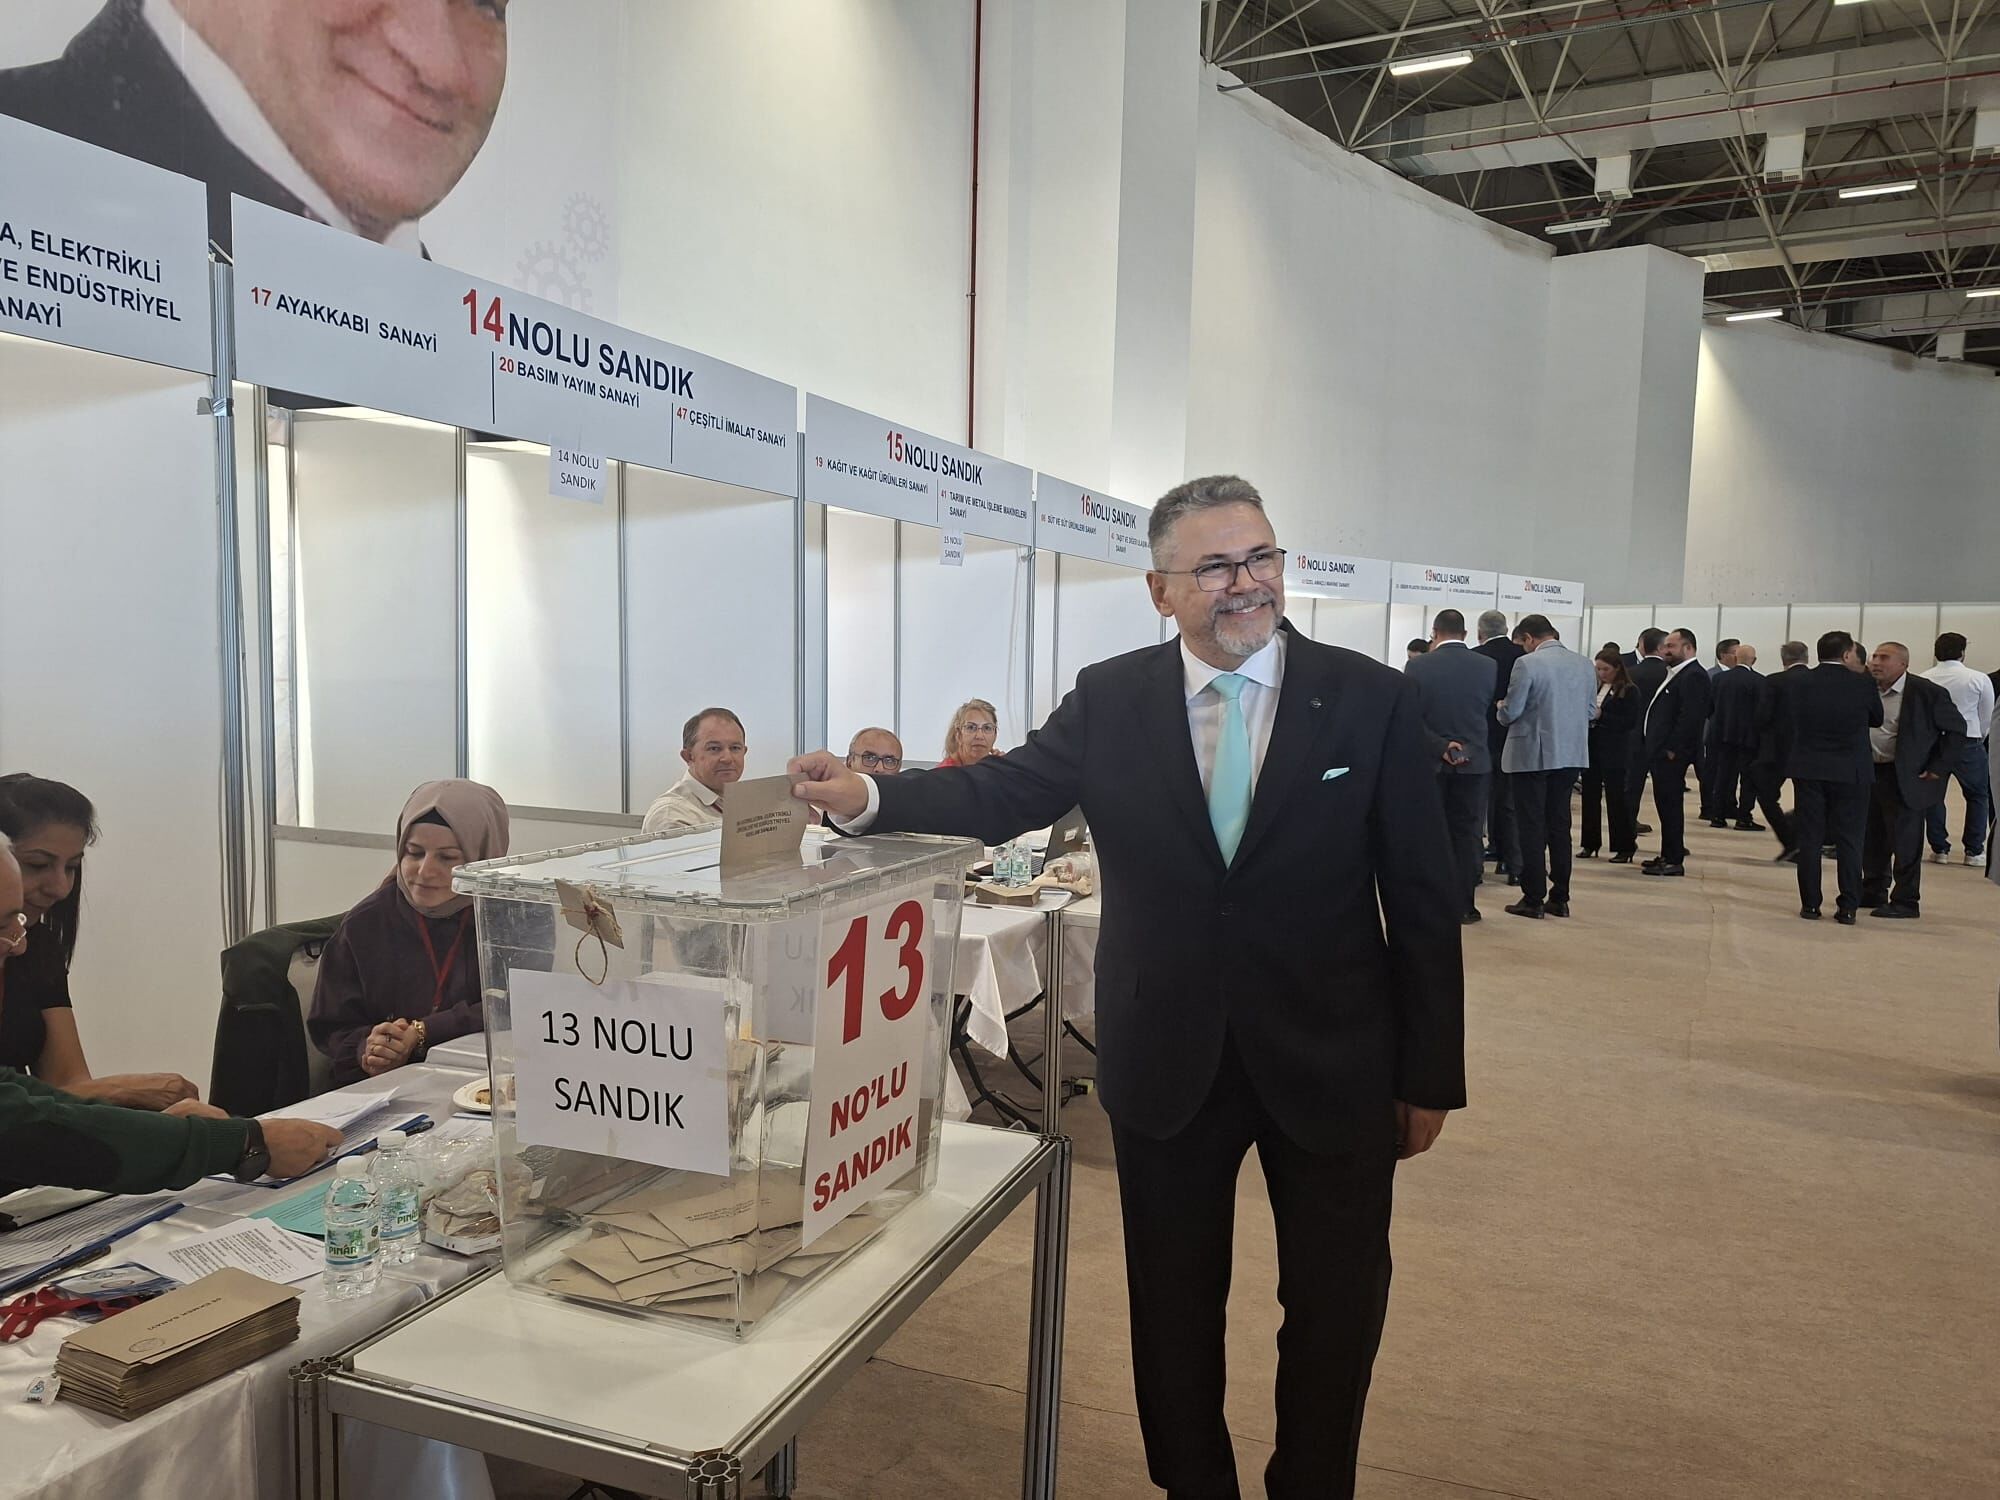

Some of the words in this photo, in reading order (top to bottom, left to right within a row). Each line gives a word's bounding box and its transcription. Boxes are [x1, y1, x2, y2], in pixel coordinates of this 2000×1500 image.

[31, 229, 161, 284] ELEKTRİKLİ
[0, 258, 19, 282] E
[27, 264, 181, 322] ENDÜSTRİYEL
[251, 286, 271, 306] 17
[276, 294, 369, 334] AYAKKABI
[379, 322, 437, 352] SANAYİ
[499, 356, 514, 373] 20
[518, 361, 558, 386] BASIM
[562, 373, 596, 396] YAYIM
[599, 385, 639, 408] SANAYİ
[599, 343, 694, 400] SANDIK
[676, 406, 687, 420] 47
[689, 410, 724, 430] ÇEŞİTLİ
[725, 417, 755, 439] İMALAT
[757, 430, 786, 448] SANAYİ
[558, 449, 569, 463] 14
[572, 453, 599, 470] NOLU
[815, 456, 823, 468] 19
[827, 458, 847, 474] KAĞIT
[849, 464, 858, 477] VE
[859, 467, 877, 481] KAĞIT
[879, 470, 908, 488] ÜRÜNLERİ
[909, 480, 929, 494] SANAYİ
[942, 455, 982, 486] SANDIK
[560, 472, 596, 491] SANDIK
[1112, 508, 1137, 529] SANDIK
[944, 549, 960, 559] SANDIK
[1329, 561, 1355, 574] SANDIK
[1449, 574, 1470, 584] SANDIK
[1545, 584, 1562, 594] SANDIK
[827, 899, 924, 1045] 13
[542, 1010, 579, 1047] 13
[594, 1017, 694, 1061] NOLU
[554, 1077, 685, 1130] SANDIK
[812, 1116, 912, 1212] SANDIK
